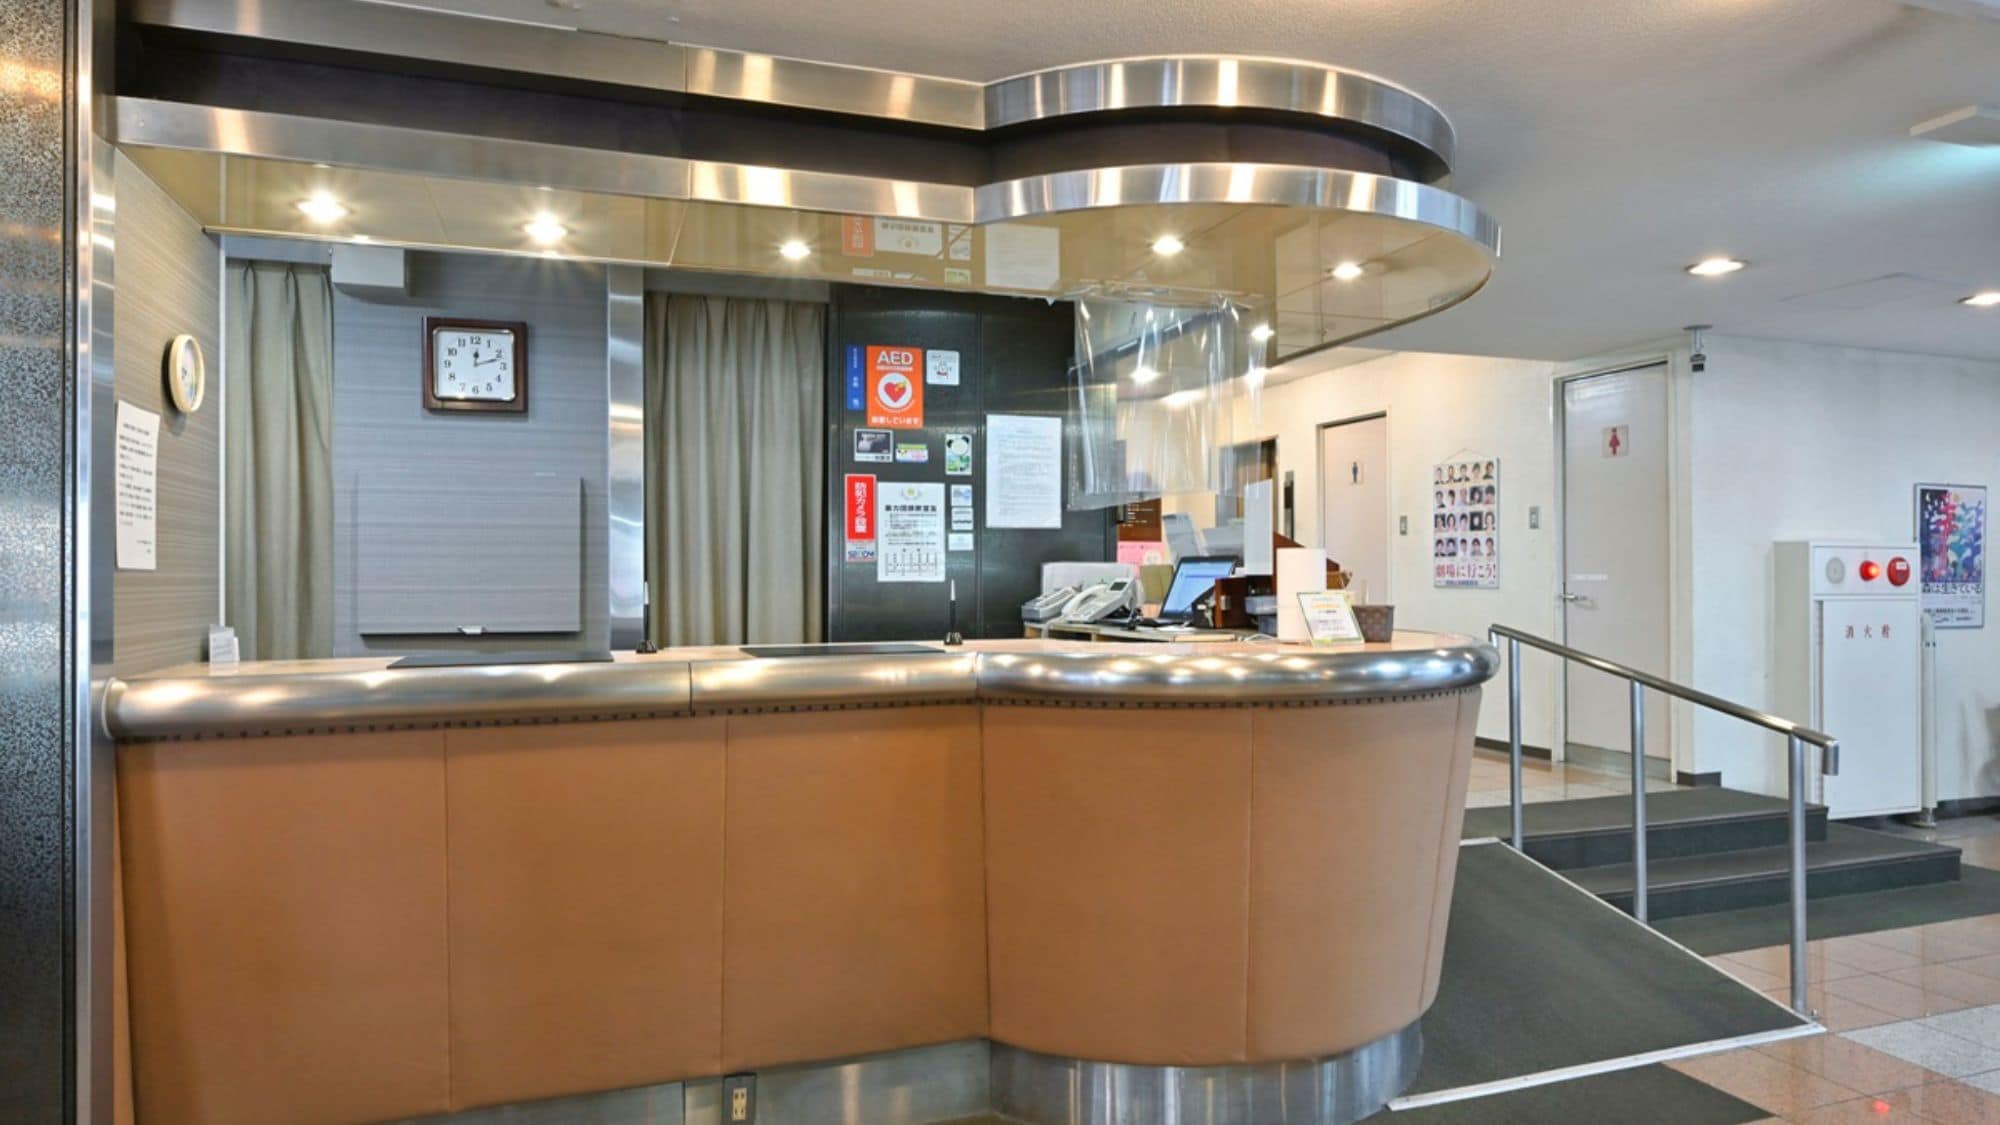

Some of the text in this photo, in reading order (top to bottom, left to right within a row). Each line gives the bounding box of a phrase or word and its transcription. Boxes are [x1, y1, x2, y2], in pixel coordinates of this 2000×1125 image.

[458, 338, 466, 347] 11
[470, 336, 481, 345] 12
[486, 339, 491, 348] 1
[448, 348, 457, 356] 10
[877, 350, 914, 366] AED
[1845, 624, 1890, 639] 消火栓
